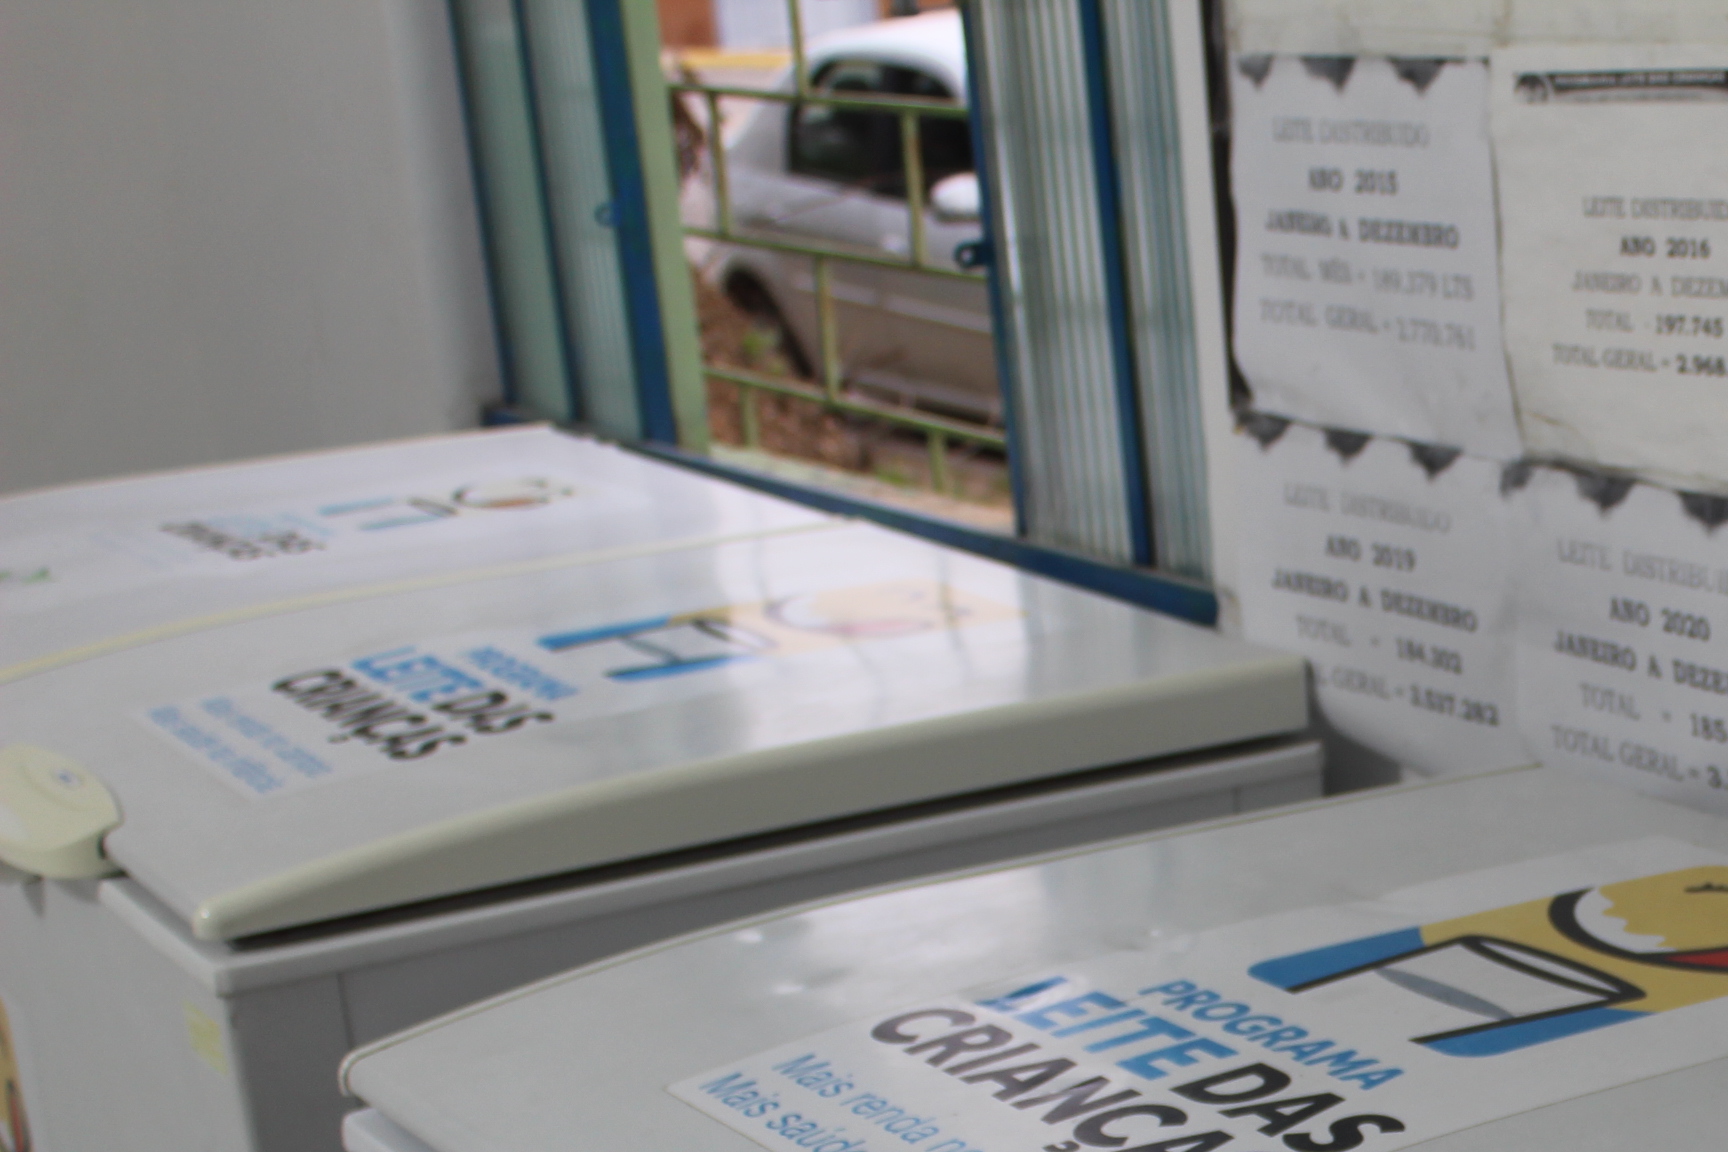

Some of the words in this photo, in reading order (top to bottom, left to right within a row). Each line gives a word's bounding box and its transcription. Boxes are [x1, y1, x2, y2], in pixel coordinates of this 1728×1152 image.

[1359, 219, 1460, 249] DEZEMBRO
[1620, 237, 1656, 257] ANO
[1667, 238, 1710, 260] 2016
[1572, 271, 1641, 295] JANEIRO
[1654, 313, 1724, 338] 197.745
[1326, 535, 1360, 561] ANO
[1557, 538, 1612, 572] LEITE
[1272, 569, 1348, 603] JANEIRO
[1380, 590, 1478, 633] DEZEMBRO
[1609, 597, 1650, 628] ANO
[1660, 607, 1711, 642] 2020
[1554, 630, 1636, 671] JANEIRO
[1648, 654, 1661, 678] A
[1579, 682, 1641, 722] TOTAL
[1550, 725, 1615, 764] TOTAL
[1619, 740, 1686, 782] GERAL
[972, 975, 1239, 1081] LEITE
[1139, 979, 1405, 1091] PROGRAMA
[700, 1072, 779, 1120] Mais
[773, 1053, 855, 1099] Mais
[841, 1082, 939, 1145] renda
